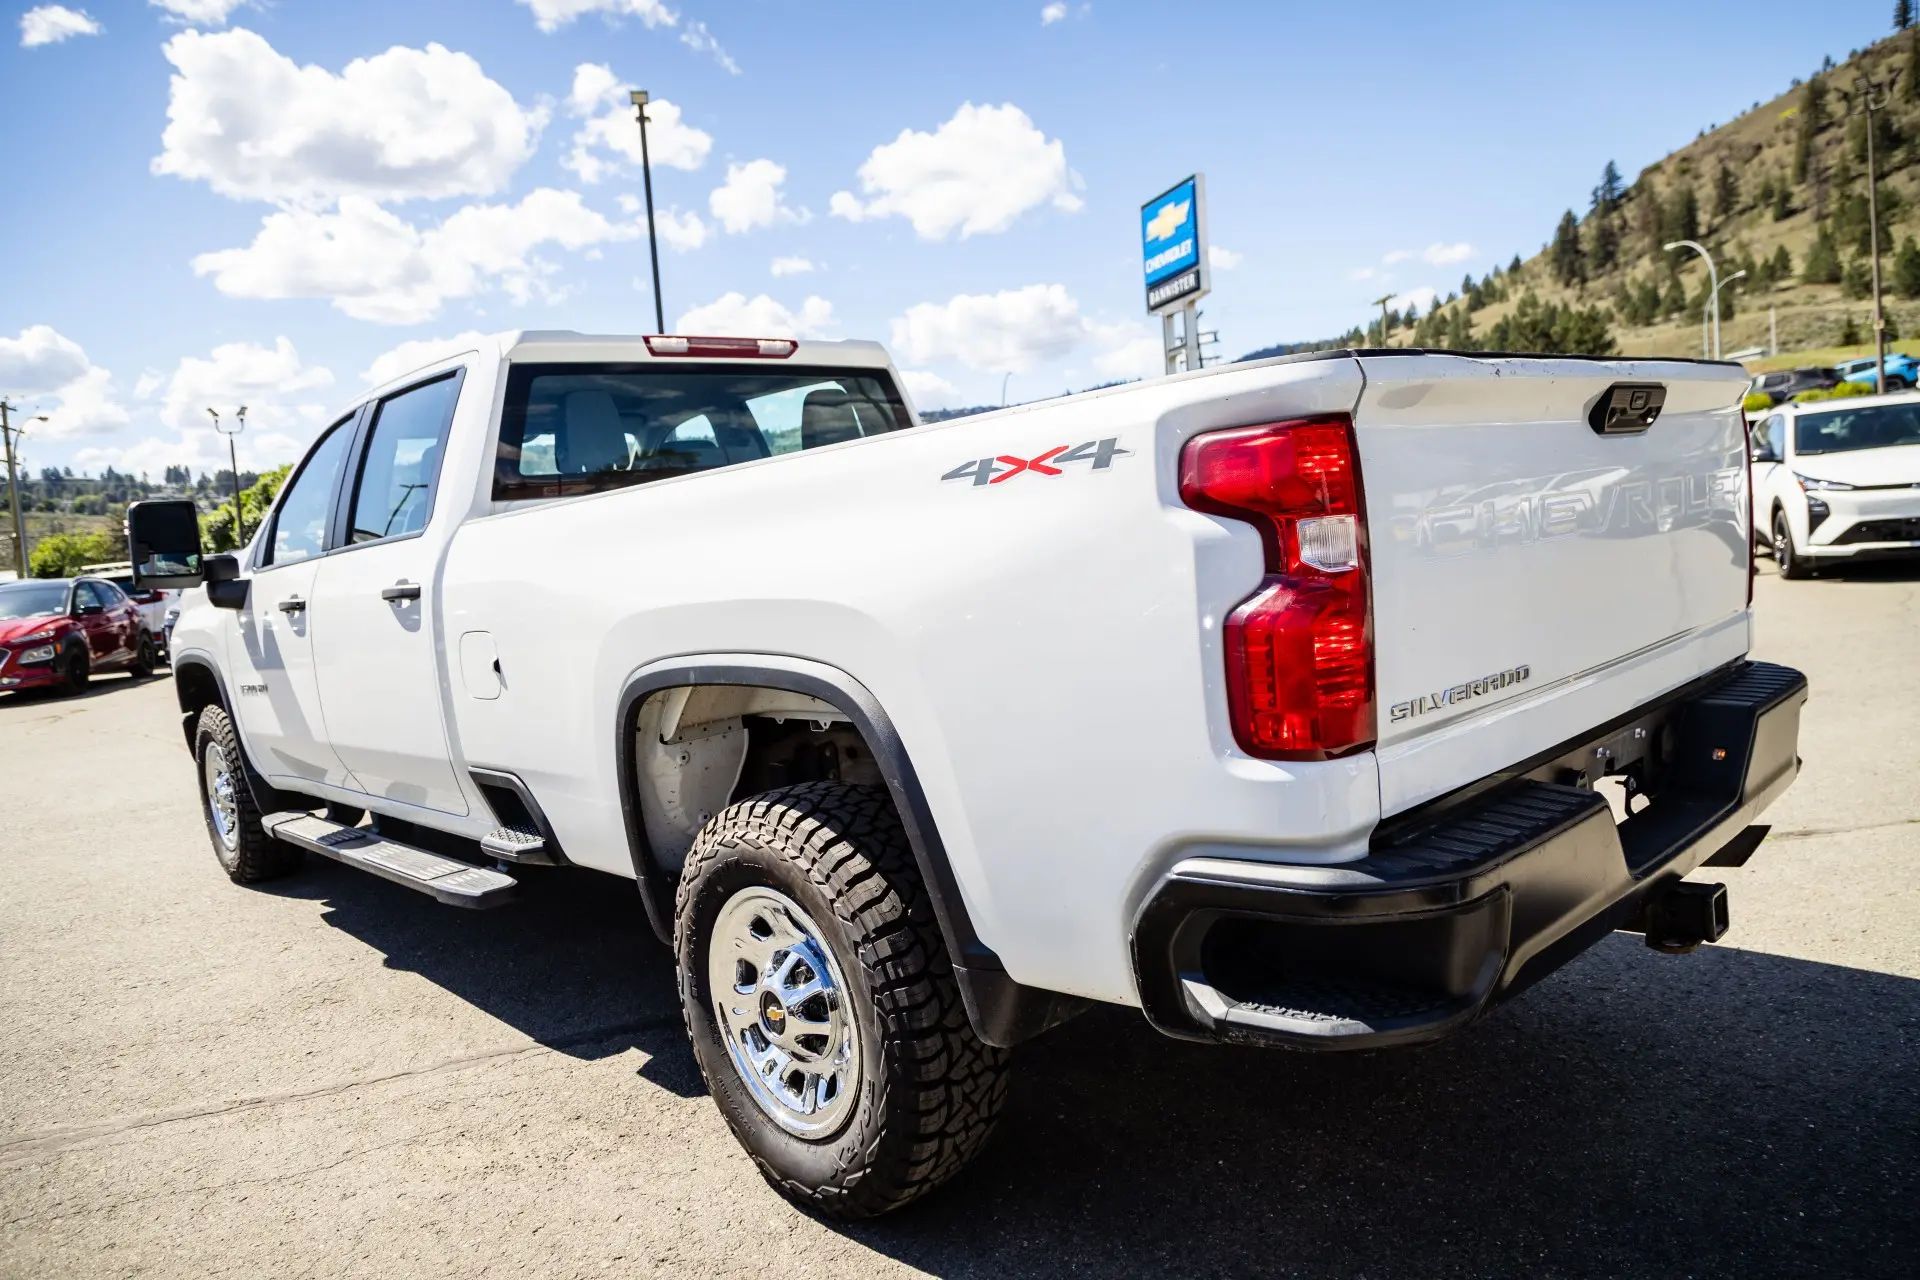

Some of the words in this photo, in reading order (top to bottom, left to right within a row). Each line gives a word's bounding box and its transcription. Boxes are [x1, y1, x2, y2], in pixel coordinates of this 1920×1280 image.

[1145, 238, 1193, 274] CHEVROLET
[1149, 273, 1196, 306] BANNISTER
[940, 437, 1130, 487] 4X4
[1415, 466, 1741, 561] CHEVROLET
[1390, 664, 1531, 723] SILVERADO
